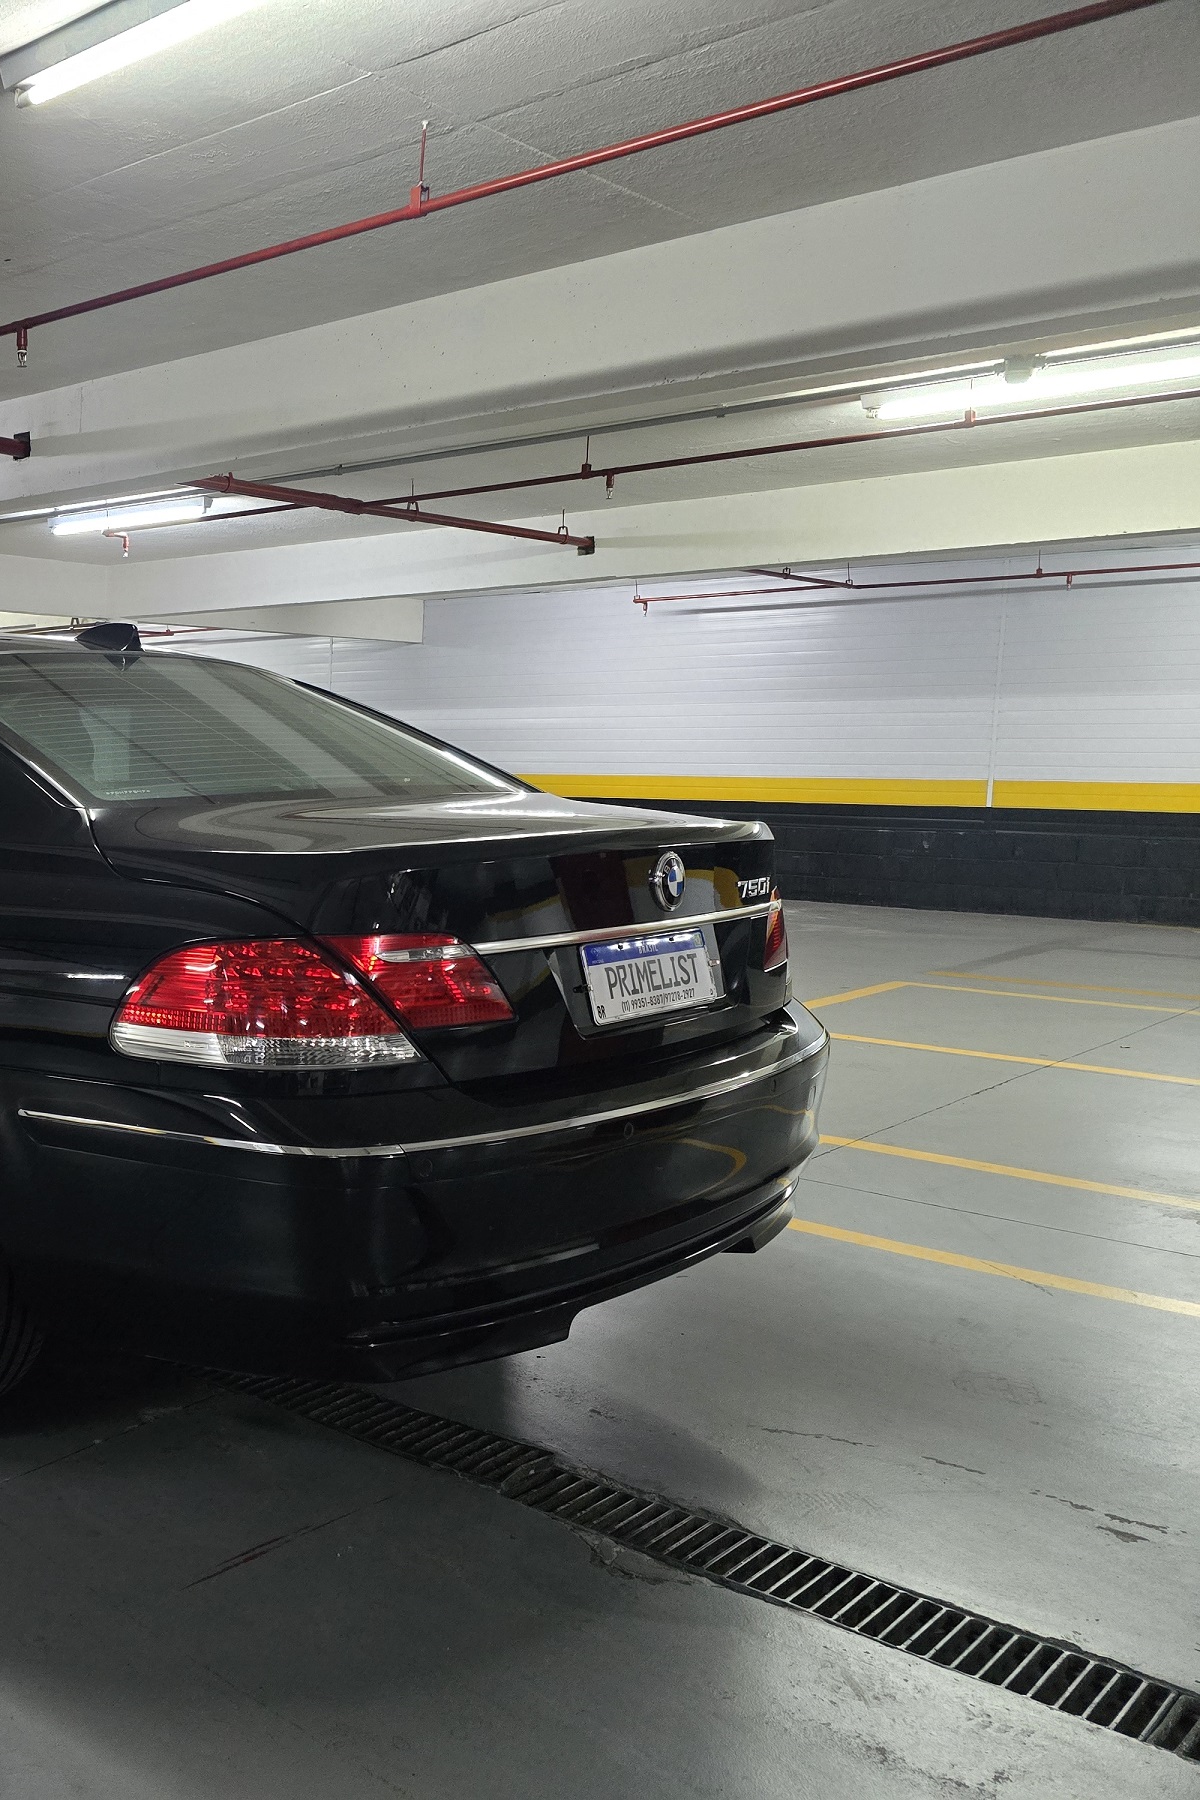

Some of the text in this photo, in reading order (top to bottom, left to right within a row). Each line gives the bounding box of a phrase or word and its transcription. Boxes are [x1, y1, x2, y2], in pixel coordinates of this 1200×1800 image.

[738, 877, 770, 898] 750i
[604, 953, 698, 1000] PRIMELIST
[596, 1005, 607, 1019] BR
